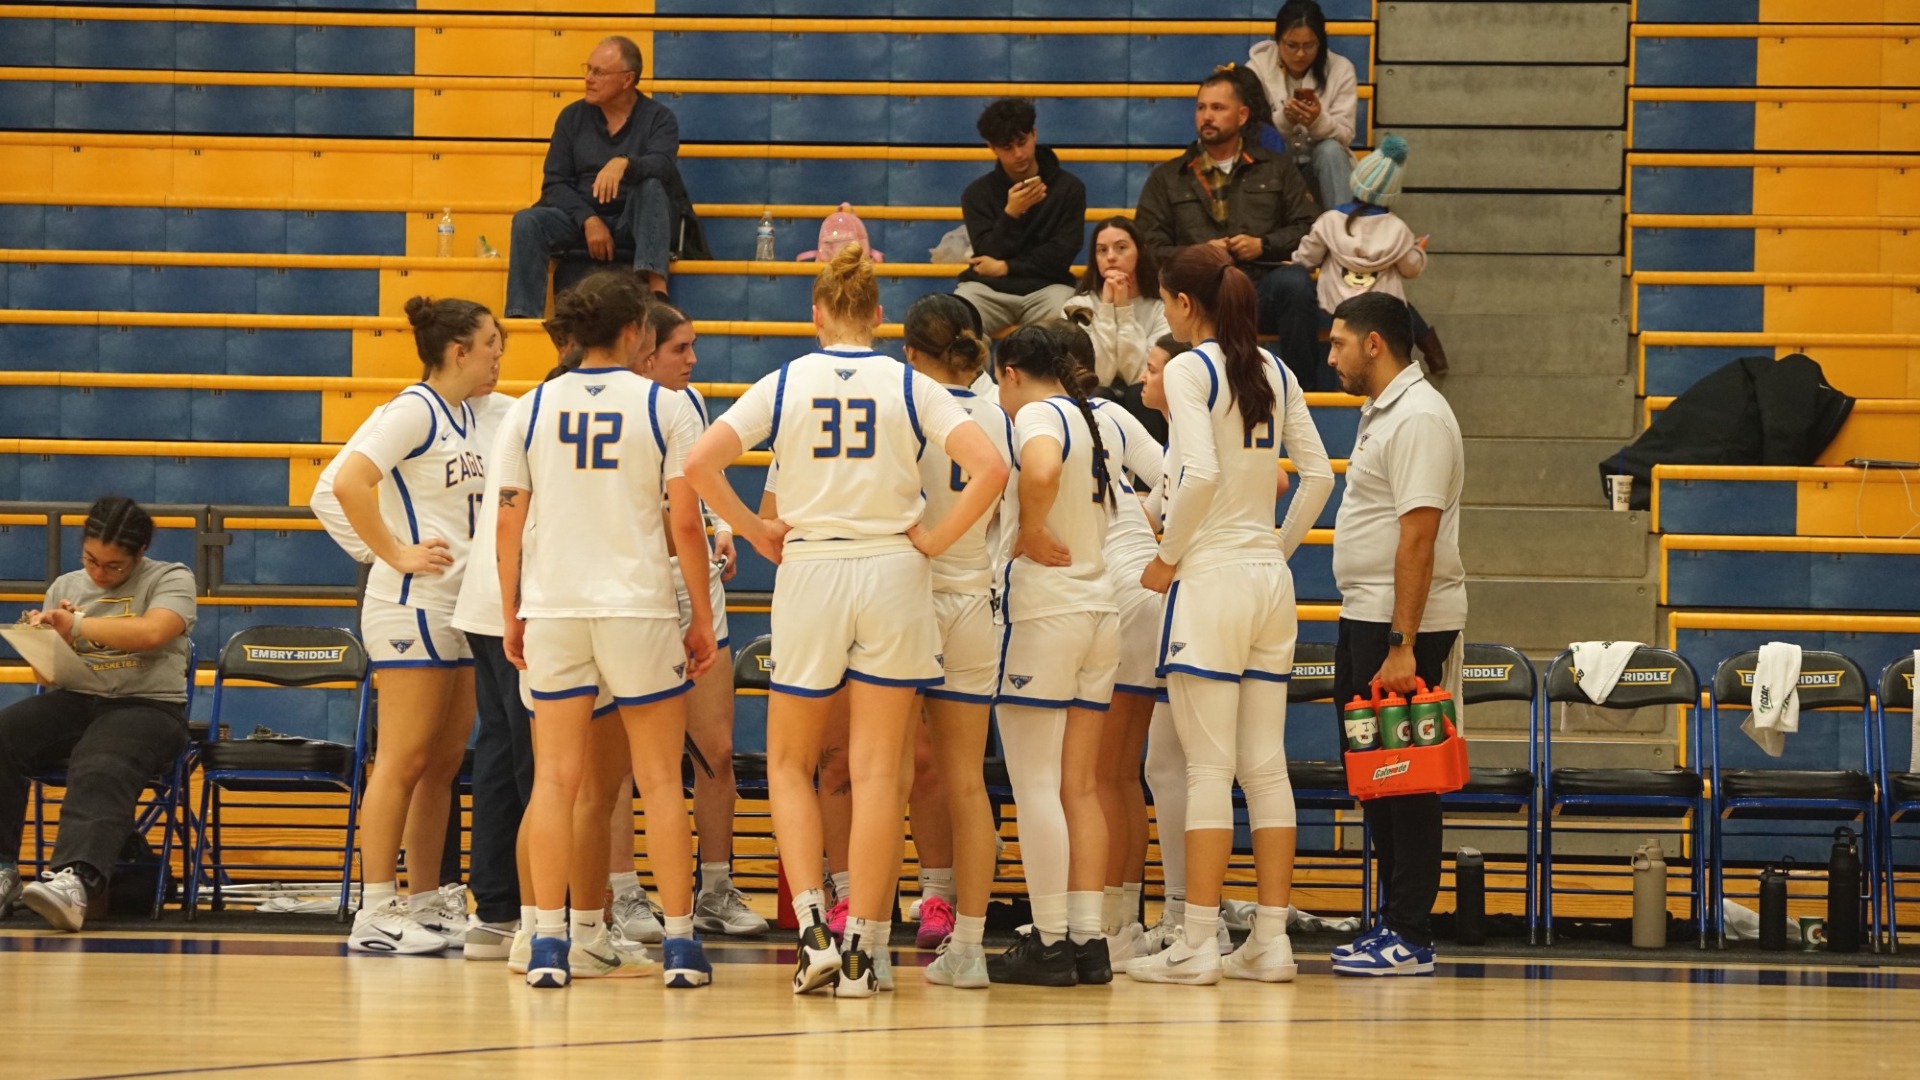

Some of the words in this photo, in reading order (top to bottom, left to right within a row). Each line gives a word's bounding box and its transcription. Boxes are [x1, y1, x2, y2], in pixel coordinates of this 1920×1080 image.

[558, 411, 623, 470] 42
[812, 398, 876, 459] 33
[251, 649, 339, 660] EMBRY-RIDDLE
